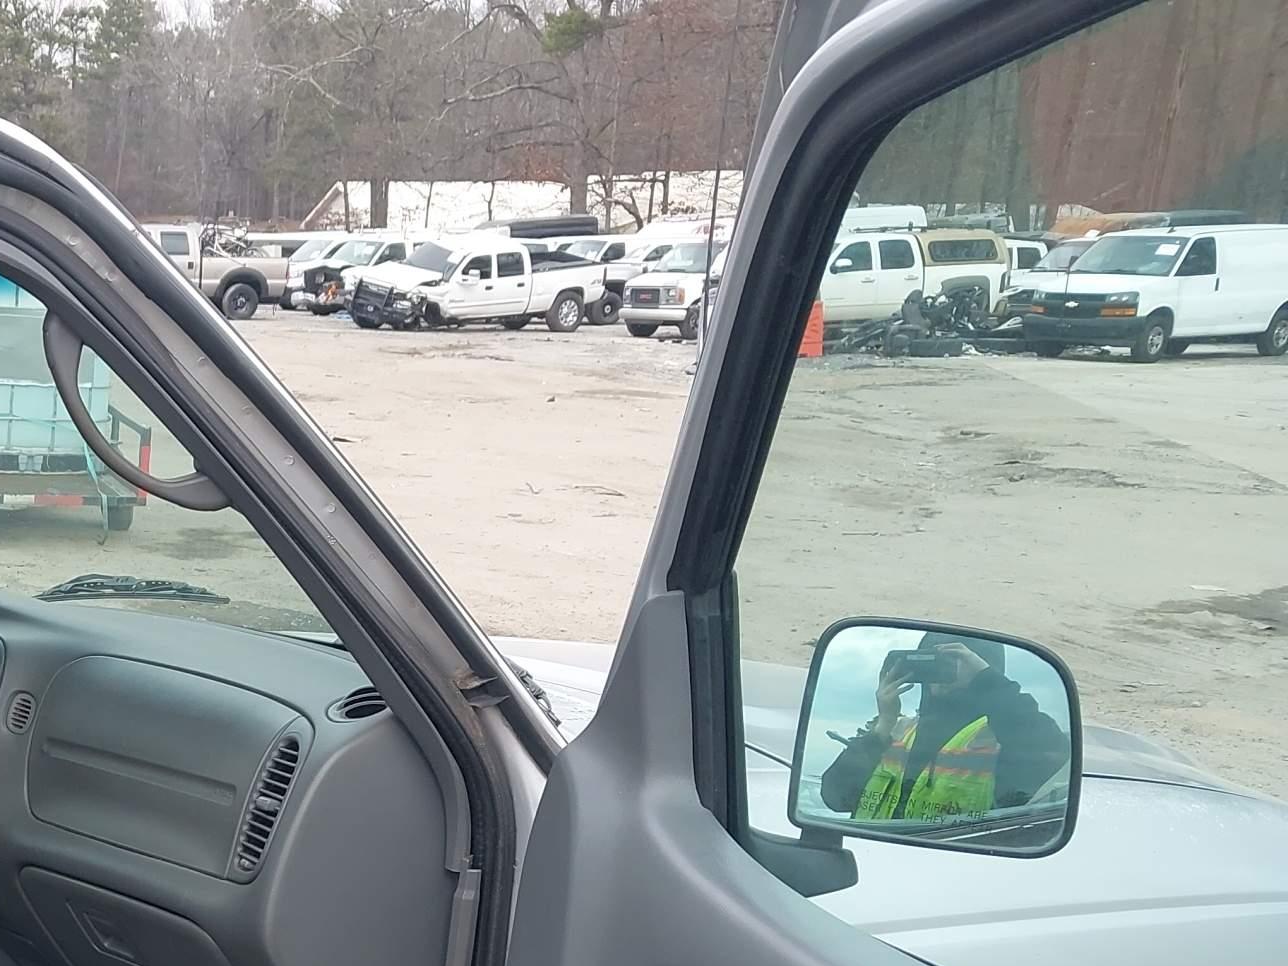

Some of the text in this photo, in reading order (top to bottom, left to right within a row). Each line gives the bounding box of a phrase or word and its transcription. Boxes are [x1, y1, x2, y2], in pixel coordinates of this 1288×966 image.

[854, 789, 898, 805] BJECTS
[967, 810, 987, 820] ARE
[920, 812, 946, 824] THEY
